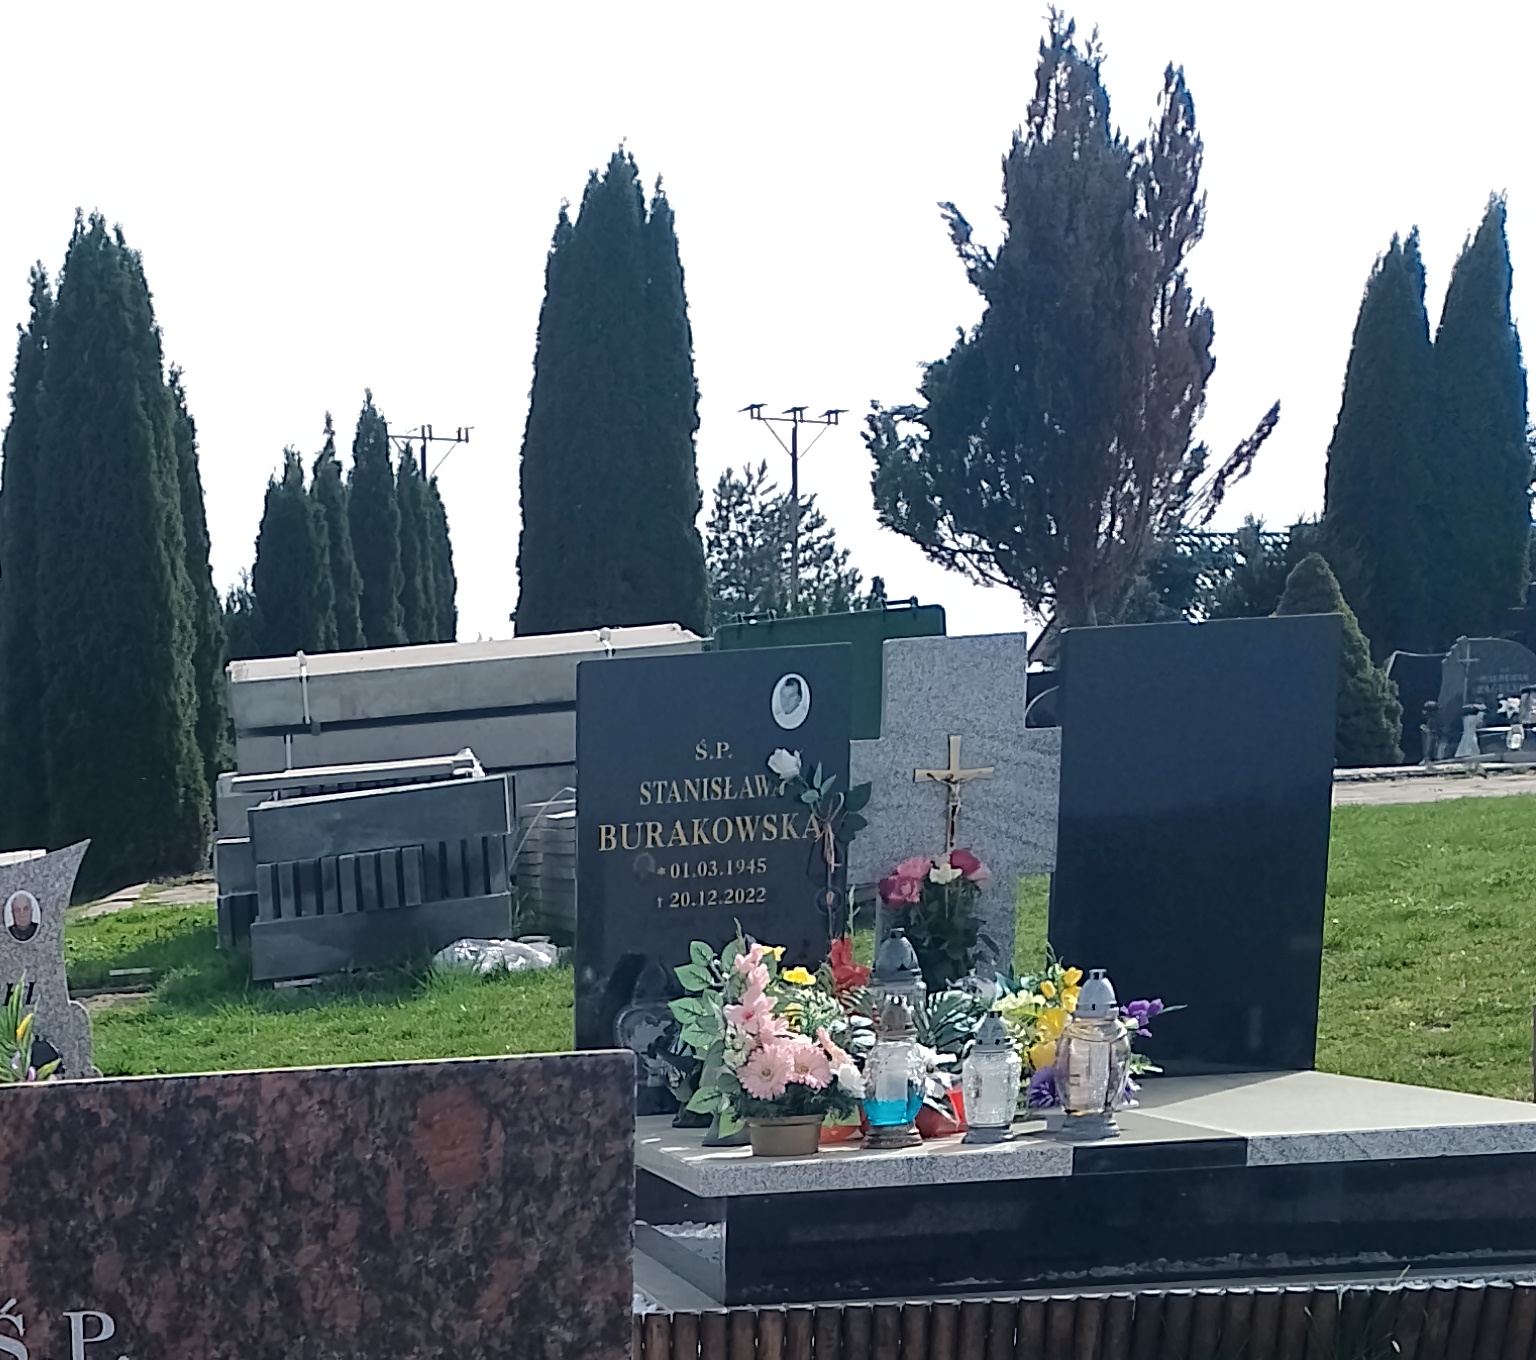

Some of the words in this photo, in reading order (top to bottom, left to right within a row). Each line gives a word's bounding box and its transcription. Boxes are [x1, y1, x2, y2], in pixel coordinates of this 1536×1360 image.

[598, 812, 820, 851] BURAKOWSKA
[669, 858, 767, 879] 01.03.1945
[669, 888, 766, 908] 20.12.2022
